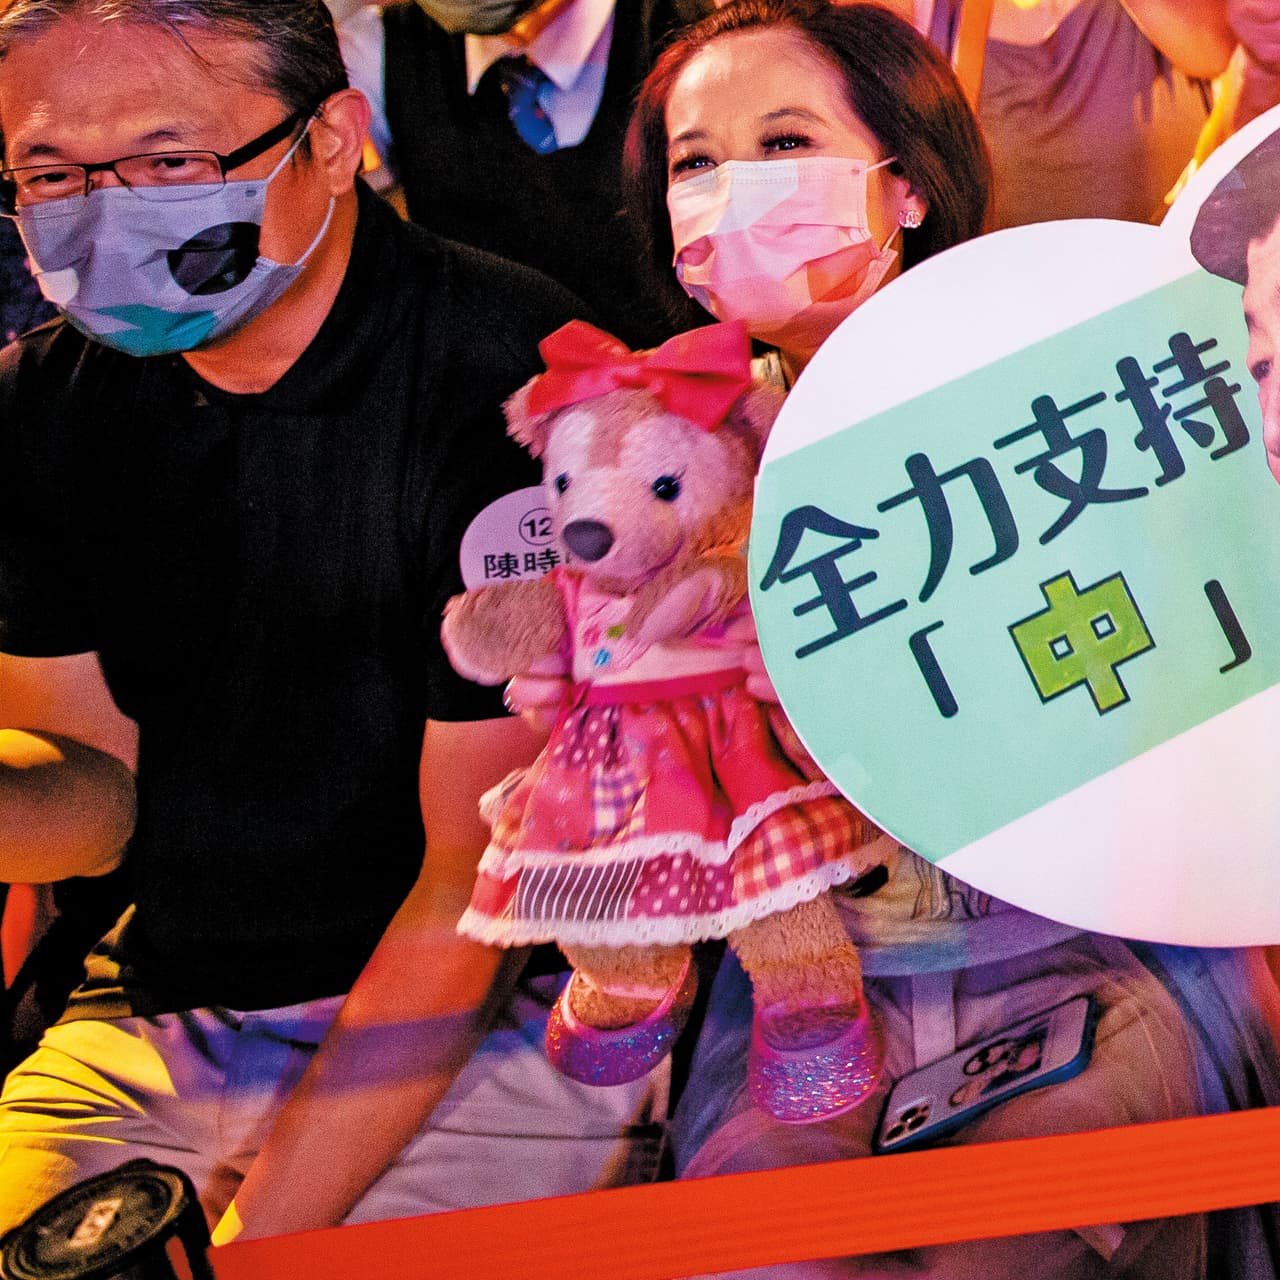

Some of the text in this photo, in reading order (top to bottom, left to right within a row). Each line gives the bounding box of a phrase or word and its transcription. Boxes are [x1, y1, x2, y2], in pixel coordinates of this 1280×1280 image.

[483, 548, 572, 579] 陳時
[758, 331, 1252, 660] 全力支持
